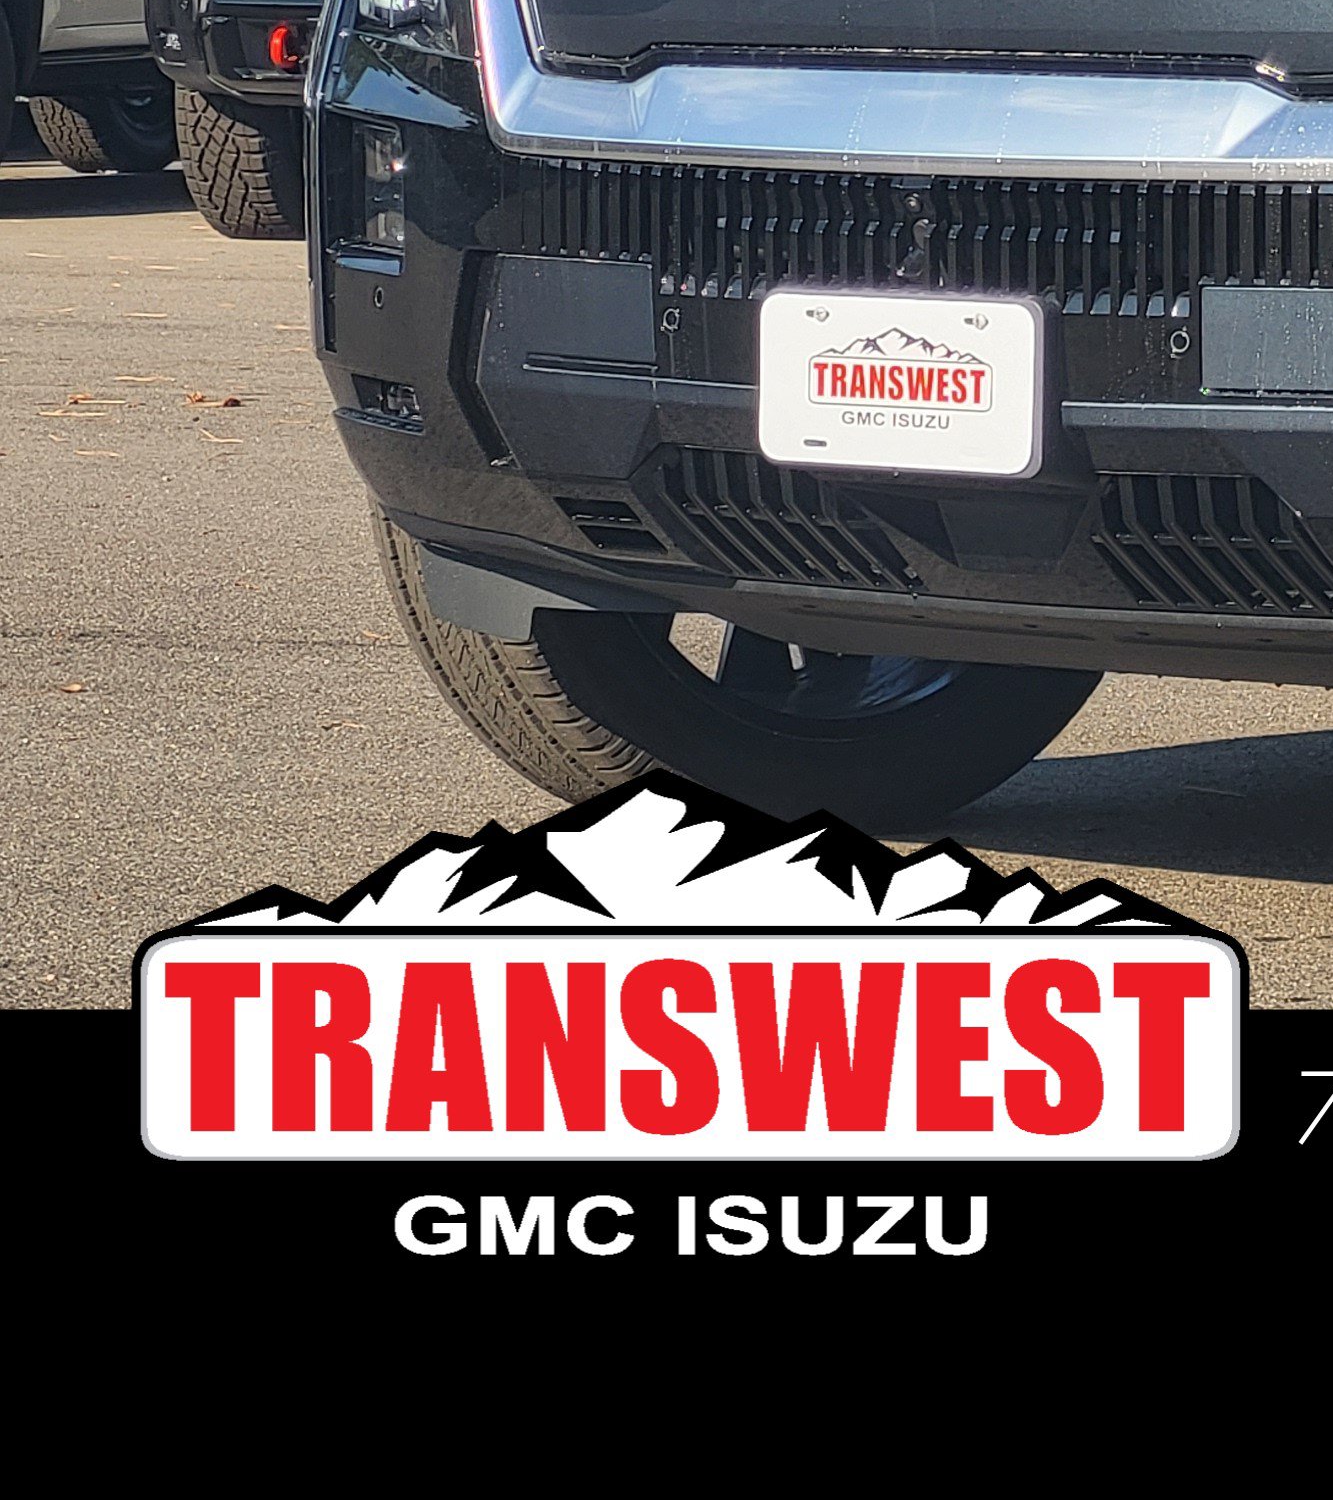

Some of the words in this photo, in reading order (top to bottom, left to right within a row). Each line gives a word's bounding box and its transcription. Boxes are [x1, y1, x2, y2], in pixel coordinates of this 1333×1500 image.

[813, 362, 985, 405] TRANSWEST
[842, 411, 886, 427] GMC
[892, 413, 951, 430] ISUZU
